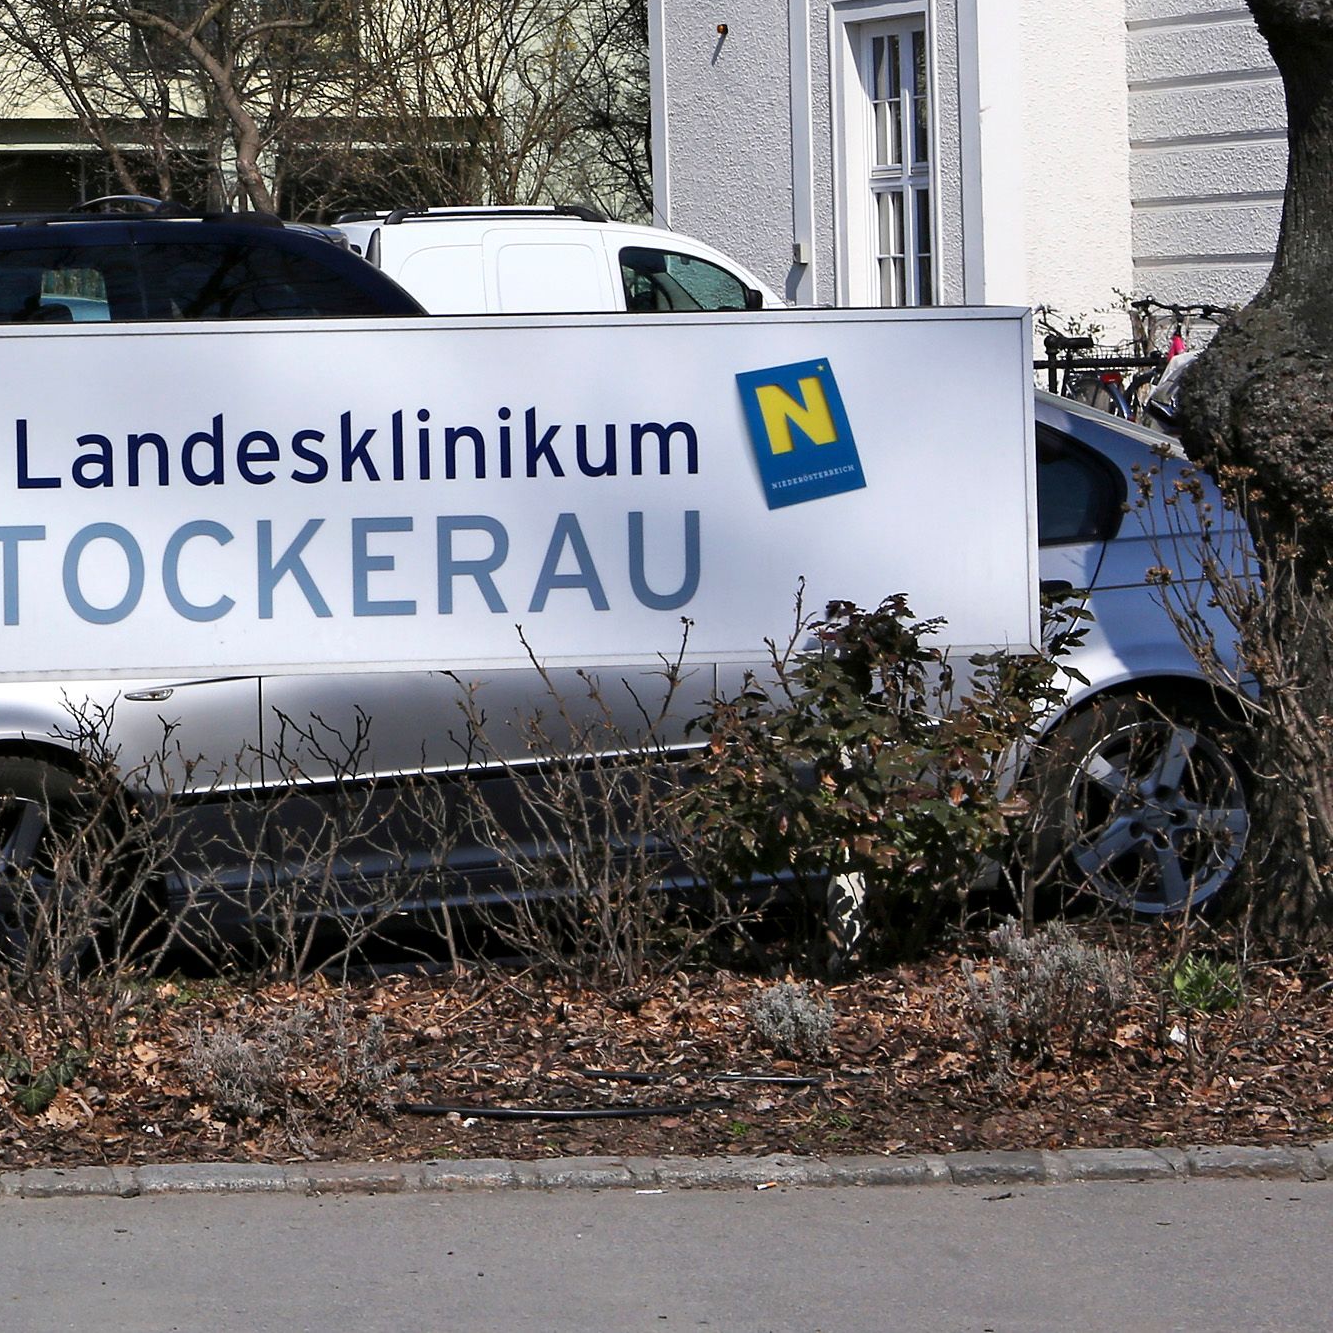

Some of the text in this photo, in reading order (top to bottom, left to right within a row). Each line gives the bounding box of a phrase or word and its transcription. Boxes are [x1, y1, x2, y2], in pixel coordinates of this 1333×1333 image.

[16, 407, 699, 489] Landesklinikum
[755, 376, 838, 455] N
[771, 464, 855, 490] NIEDERÖSTERREICH
